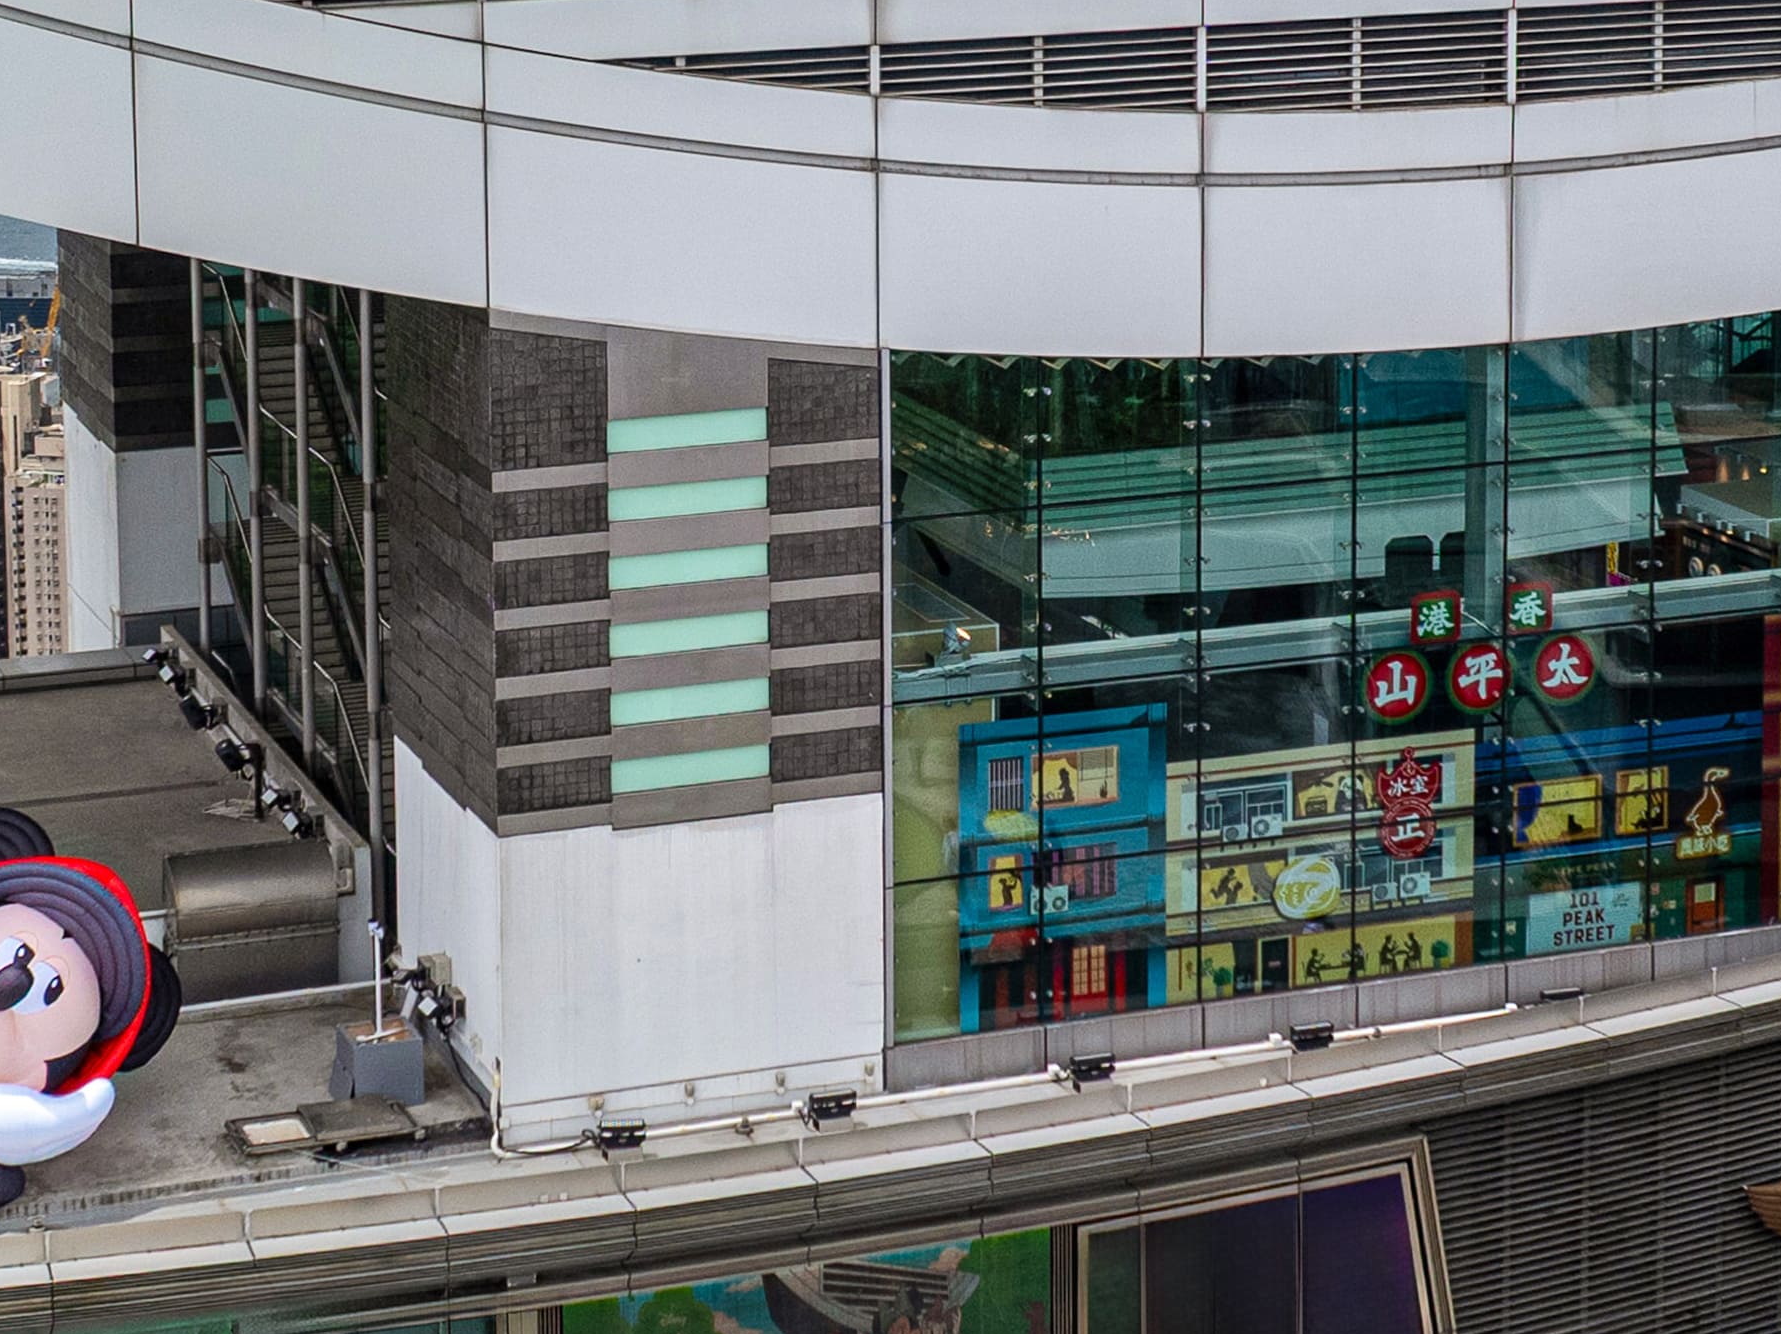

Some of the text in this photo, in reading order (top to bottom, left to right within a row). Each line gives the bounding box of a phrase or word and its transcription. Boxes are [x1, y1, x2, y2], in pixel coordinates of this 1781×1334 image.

[1388, 775, 1429, 797] 冰室
[1391, 812, 1426, 842] 正
[1570, 891, 1599, 908] 101
[1563, 908, 1605, 927] PEAK
[1553, 924, 1615, 946] STREET
